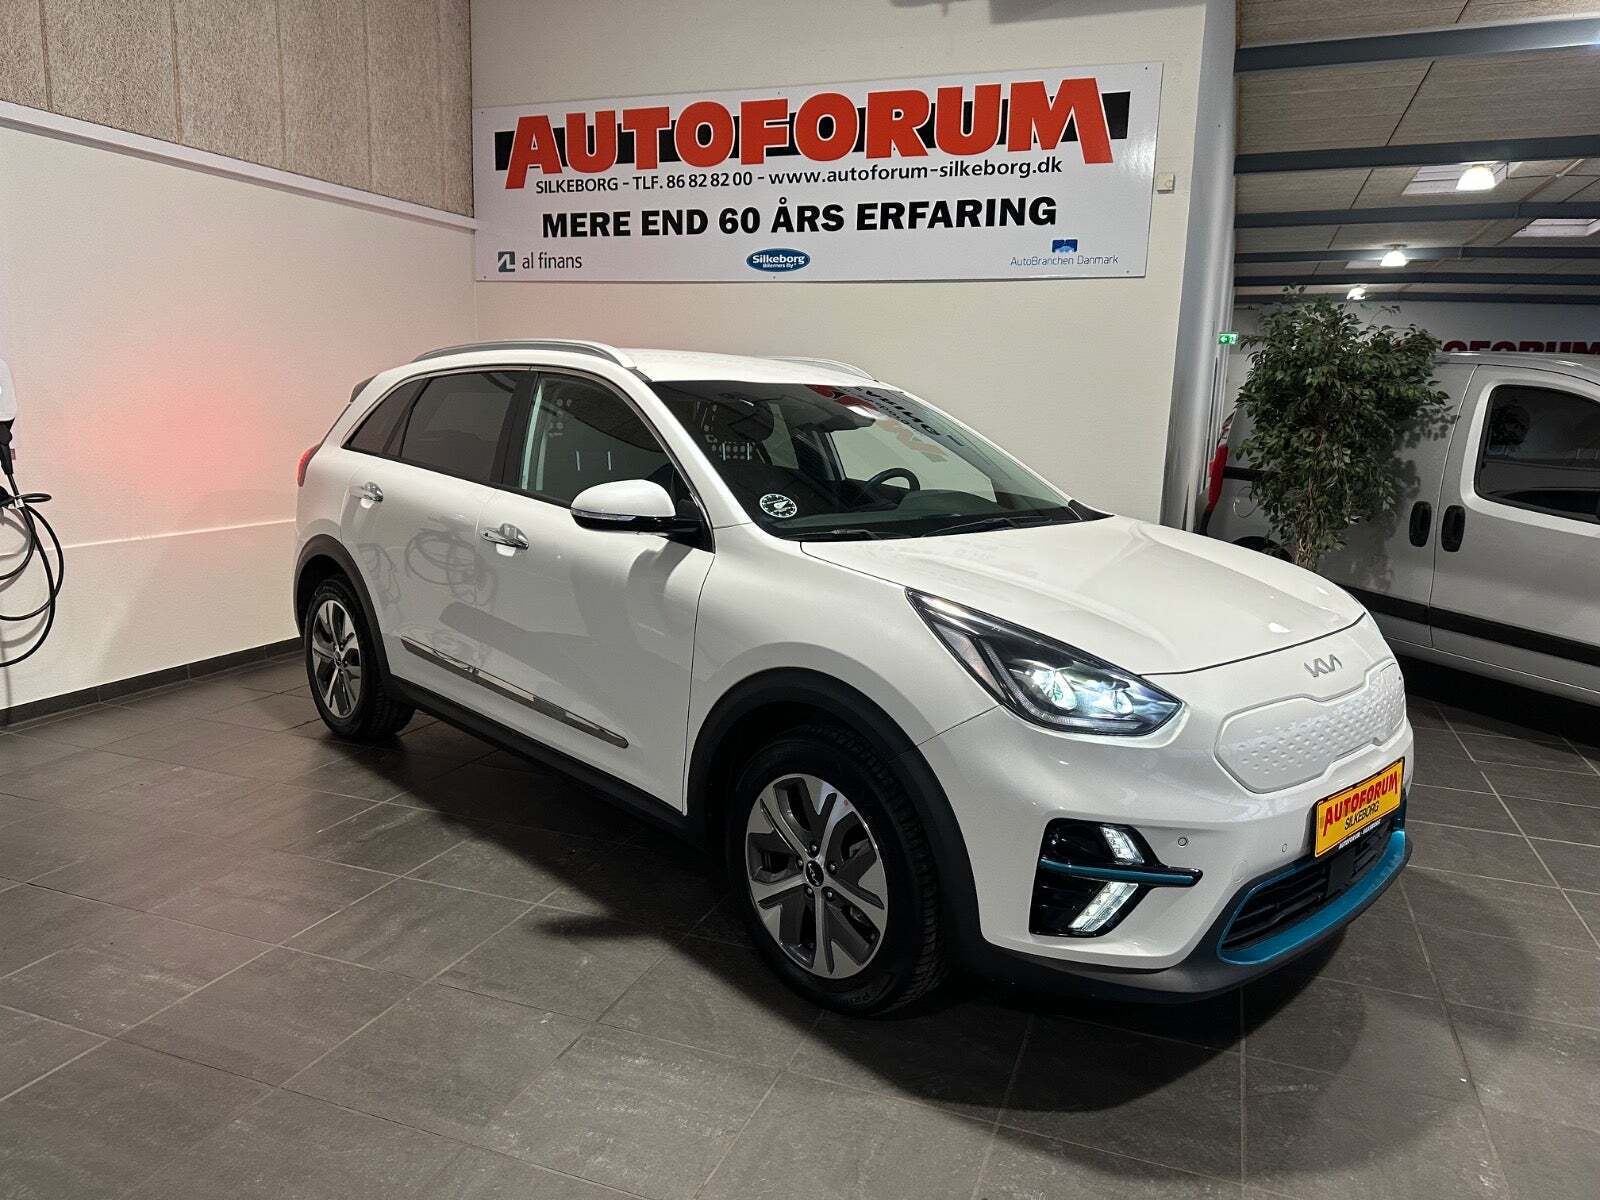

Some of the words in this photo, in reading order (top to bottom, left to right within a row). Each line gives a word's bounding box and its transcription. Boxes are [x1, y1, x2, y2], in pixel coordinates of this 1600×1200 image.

[505, 77, 1114, 190] AUTOFORUM
[535, 177, 619, 194] SILKEBORG
[632, 175, 664, 190] TLF.
[768, 156, 1064, 184] www.autoforum-silkeborg.dk
[542, 211, 631, 238] MERE
[641, 209, 709, 236] END
[718, 206, 761, 235] 60
[770, 196, 845, 233] ÅRS
[856, 195, 1058, 231] ERFARING
[522, 251, 534, 269] al
[538, 251, 583, 269] finans
[752, 254, 806, 265] Silkeborg
[1010, 255, 1074, 266] AutoBranchen
[1077, 254, 1119, 265] Danmark
[1322, 771, 1398, 837] AUTOFORUM
[1344, 800, 1380, 831] SILKEBORG
